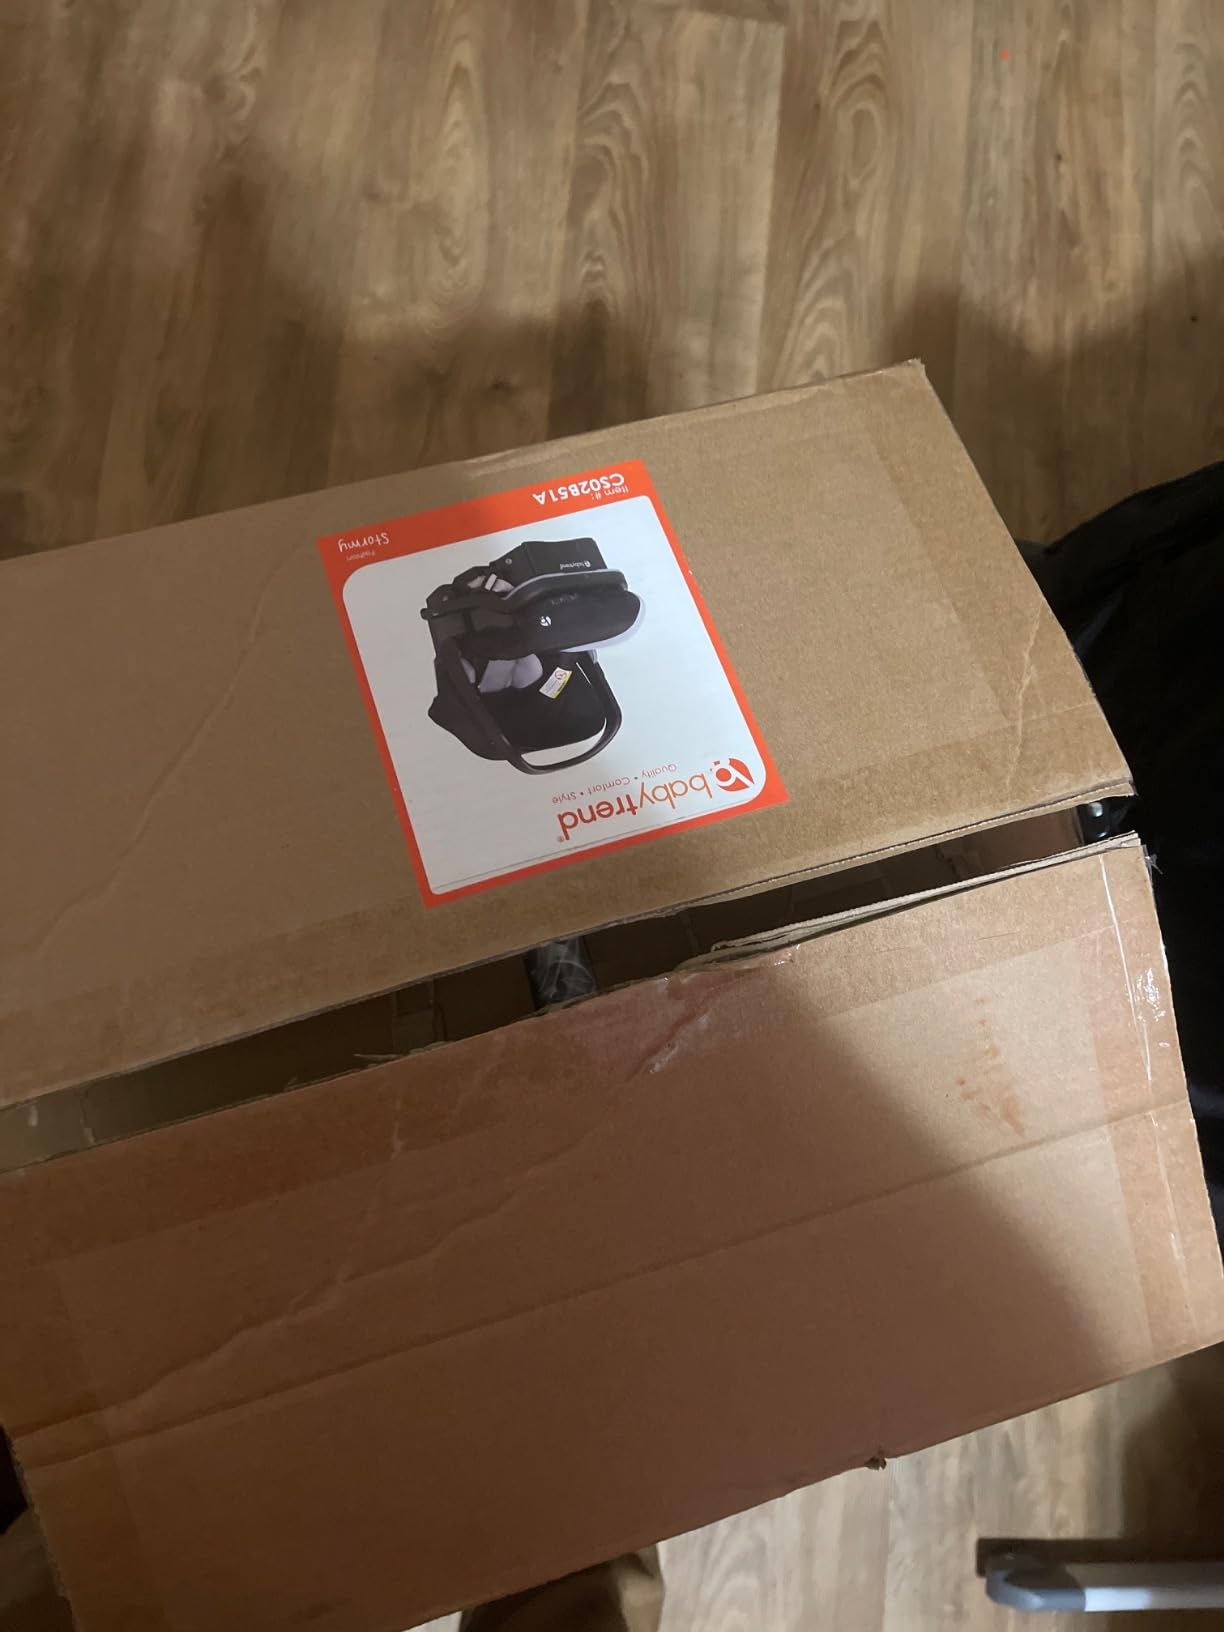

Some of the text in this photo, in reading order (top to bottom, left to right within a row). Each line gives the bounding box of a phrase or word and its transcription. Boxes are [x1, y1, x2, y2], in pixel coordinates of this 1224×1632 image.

[532, 473, 625, 505] CS02B51A
[604, 484, 629, 497] Item
[337, 532, 390, 553] Stormy
[551, 763, 677, 805] Quality Comfort Style
